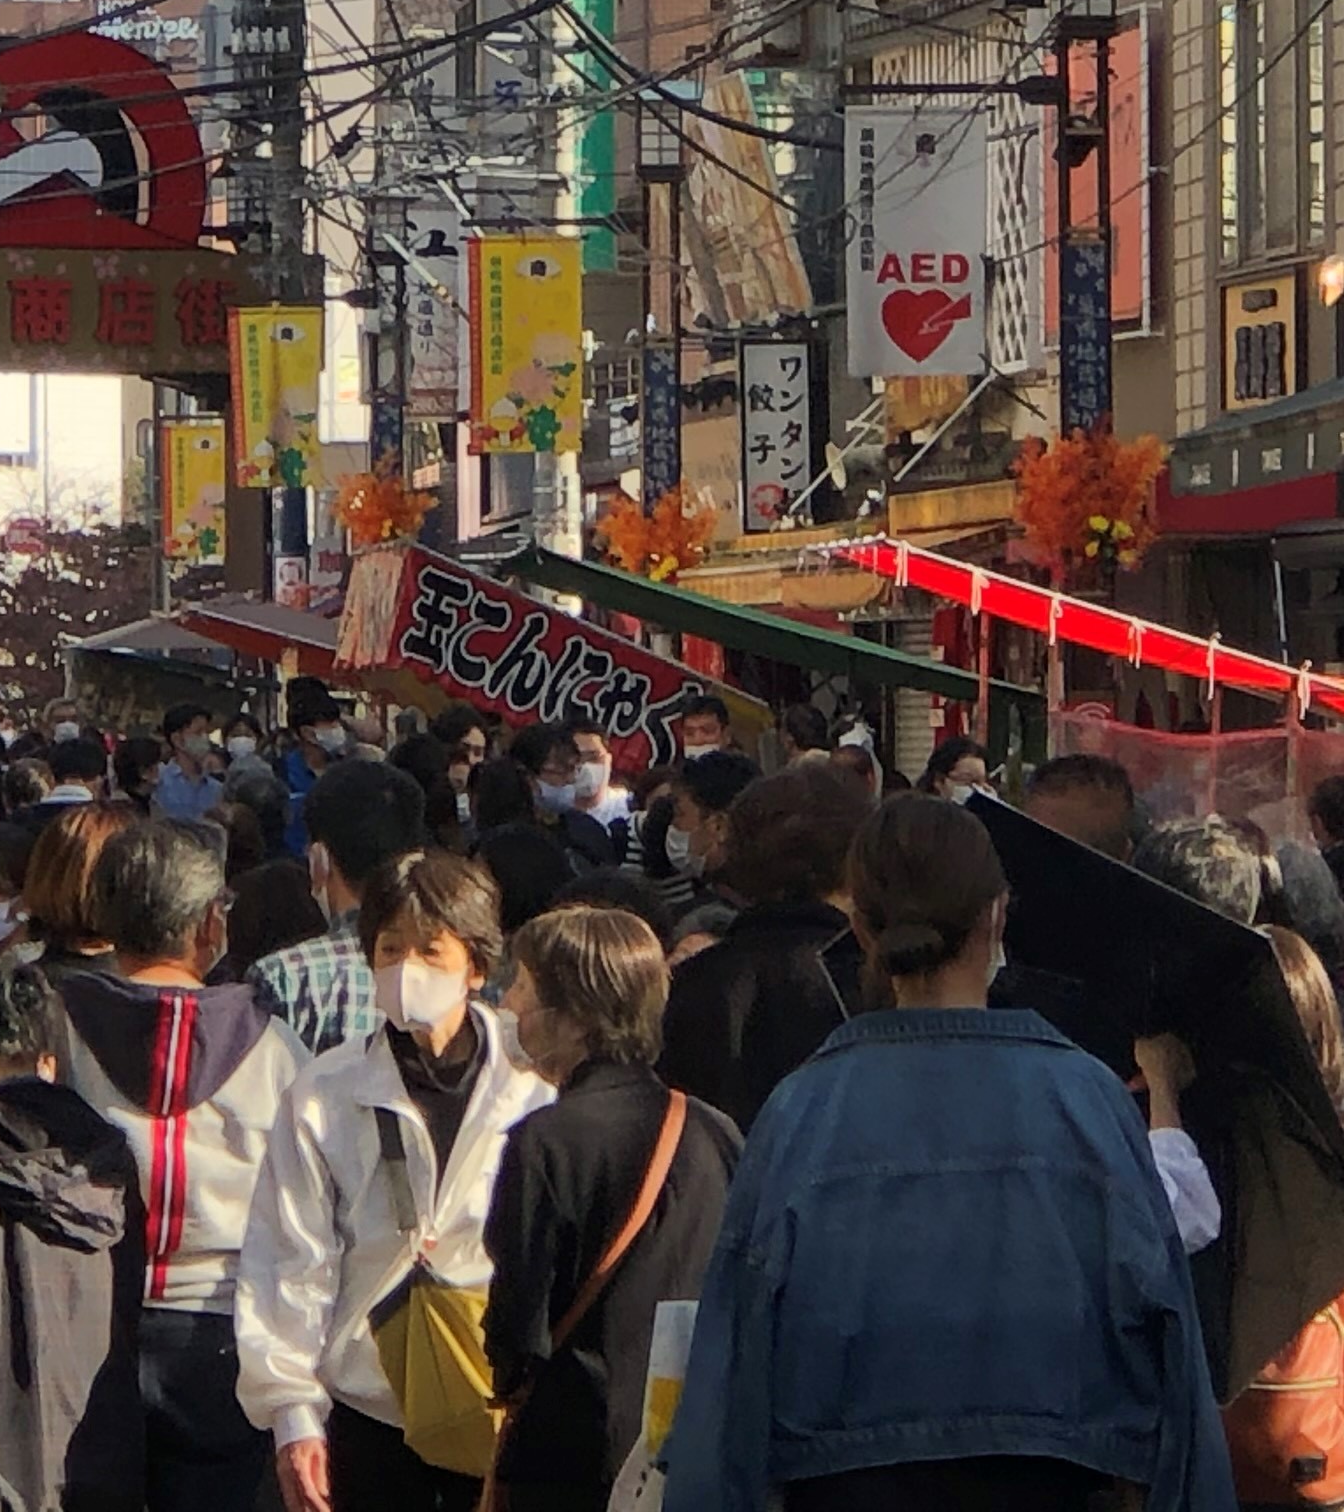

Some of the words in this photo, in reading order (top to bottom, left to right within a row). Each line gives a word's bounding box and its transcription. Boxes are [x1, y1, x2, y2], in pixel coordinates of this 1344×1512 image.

[876, 252, 970, 285] AED
[747, 383, 778, 466] 餃子
[778, 355, 806, 482] ワンタン
[400, 564, 704, 770] 玉こんにゃく
